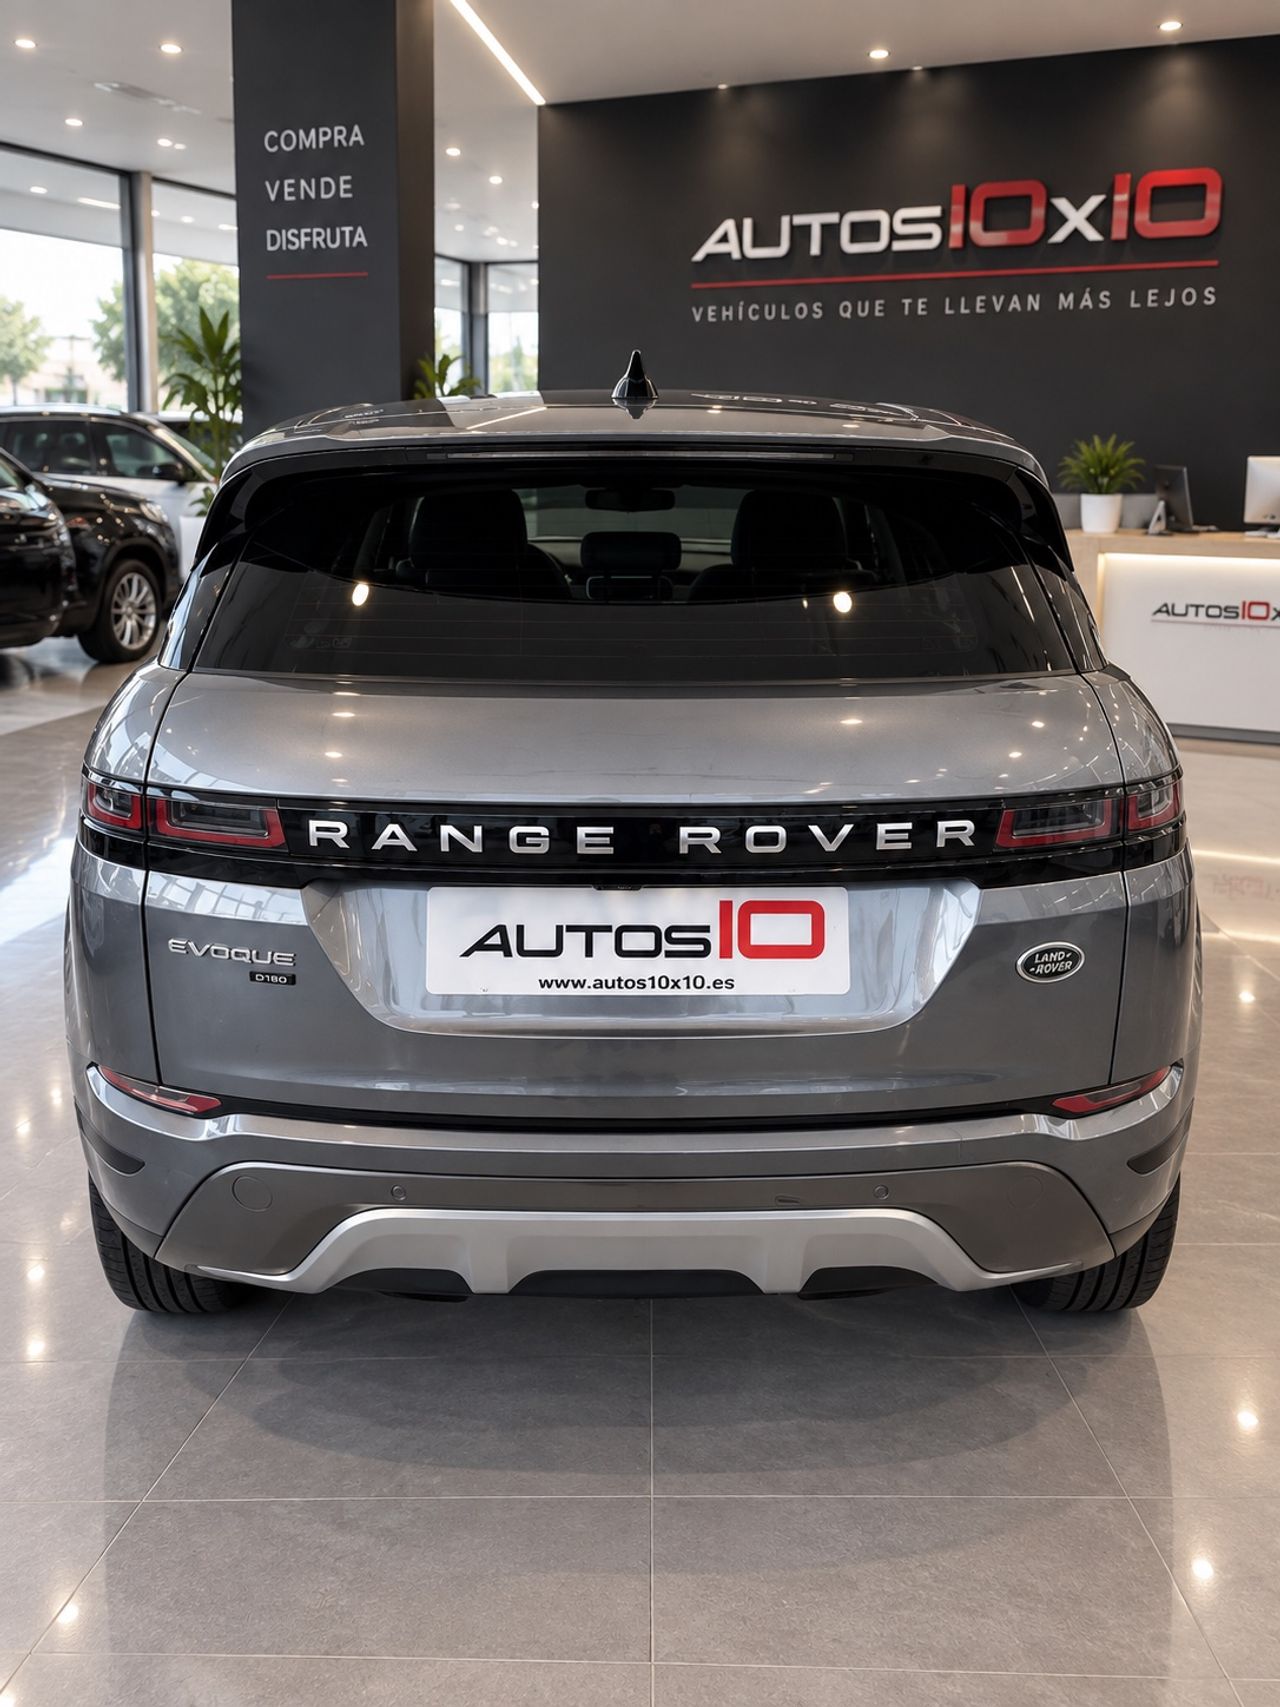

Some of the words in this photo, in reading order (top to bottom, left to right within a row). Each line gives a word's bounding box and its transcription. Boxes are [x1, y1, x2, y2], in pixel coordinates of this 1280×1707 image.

[264, 124, 365, 153] COMPRA
[265, 175, 353, 202] VENDE
[266, 226, 368, 251] DISFRUTA
[692, 301, 825, 322] VEHÍCULOS
[839, 299, 886, 319] QUE
[901, 298, 929, 316] TE
[944, 293, 1042, 315] LLEVAN
[1058, 287, 1112, 311] MÁS
[1130, 286, 1217, 308] LEJOS
[307, 819, 615, 855] RANGE
[678, 819, 976, 855] ROVER
[168, 938, 296, 966] EVOQUE
[1034, 951, 1066, 963] LAND
[255, 973, 287, 984] D180
[1034, 961, 1073, 974] ROVER
[537, 974, 735, 993] www.autos10x10.es
